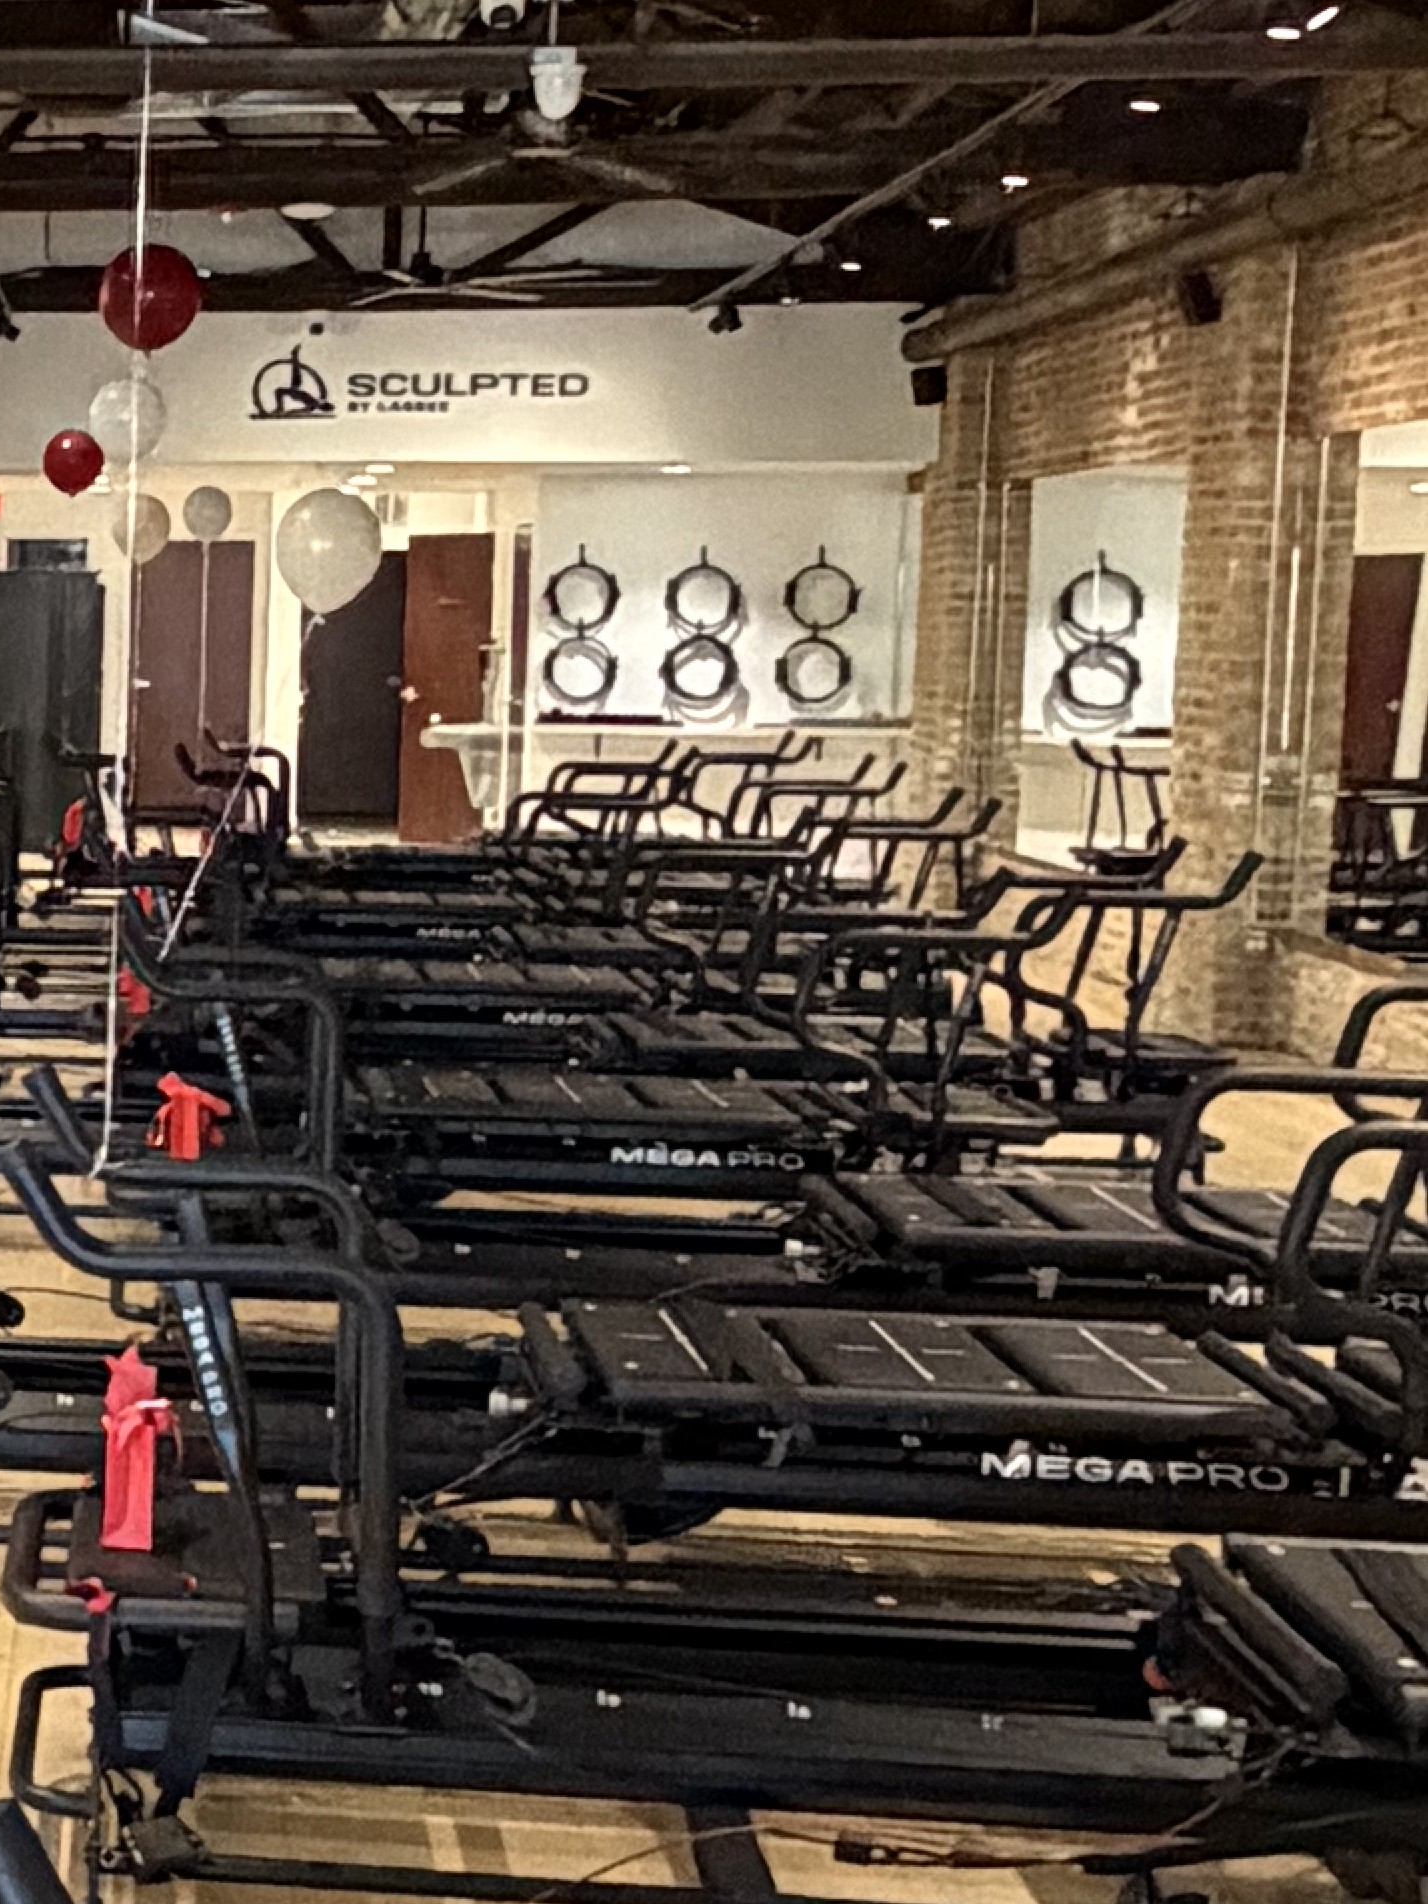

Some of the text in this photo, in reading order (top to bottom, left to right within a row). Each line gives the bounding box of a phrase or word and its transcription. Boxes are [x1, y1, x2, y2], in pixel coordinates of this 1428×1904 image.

[347, 372, 591, 397] SCULPTED
[610, 1146, 806, 1172] MEGA PRO
[980, 1451, 1290, 1492] MEGA PRO
